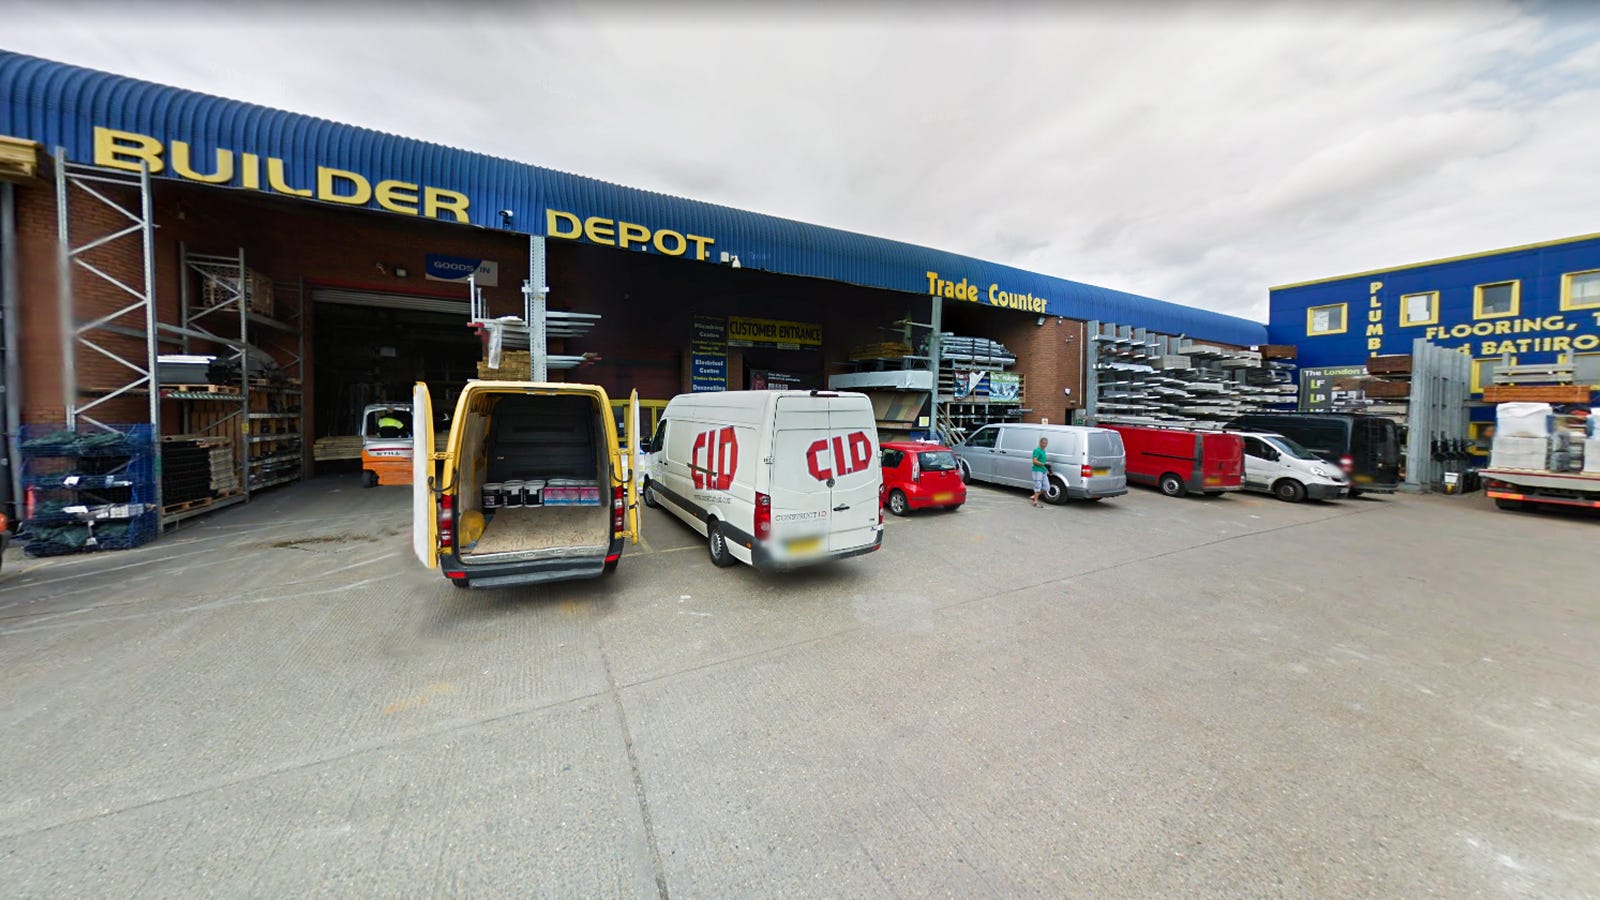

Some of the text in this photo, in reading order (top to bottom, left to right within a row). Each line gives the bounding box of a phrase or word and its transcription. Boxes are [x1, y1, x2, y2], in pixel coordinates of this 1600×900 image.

[93, 126, 715, 261] BUILDER DEPOT
[433, 260, 491, 274] GOODS IN
[926, 271, 1047, 313] Trade Counter
[729, 321, 821, 341] CUSTOMER ENTRANCE
[1425, 315, 1577, 341] FLOORING,
[1323, 368, 1361, 376] London
